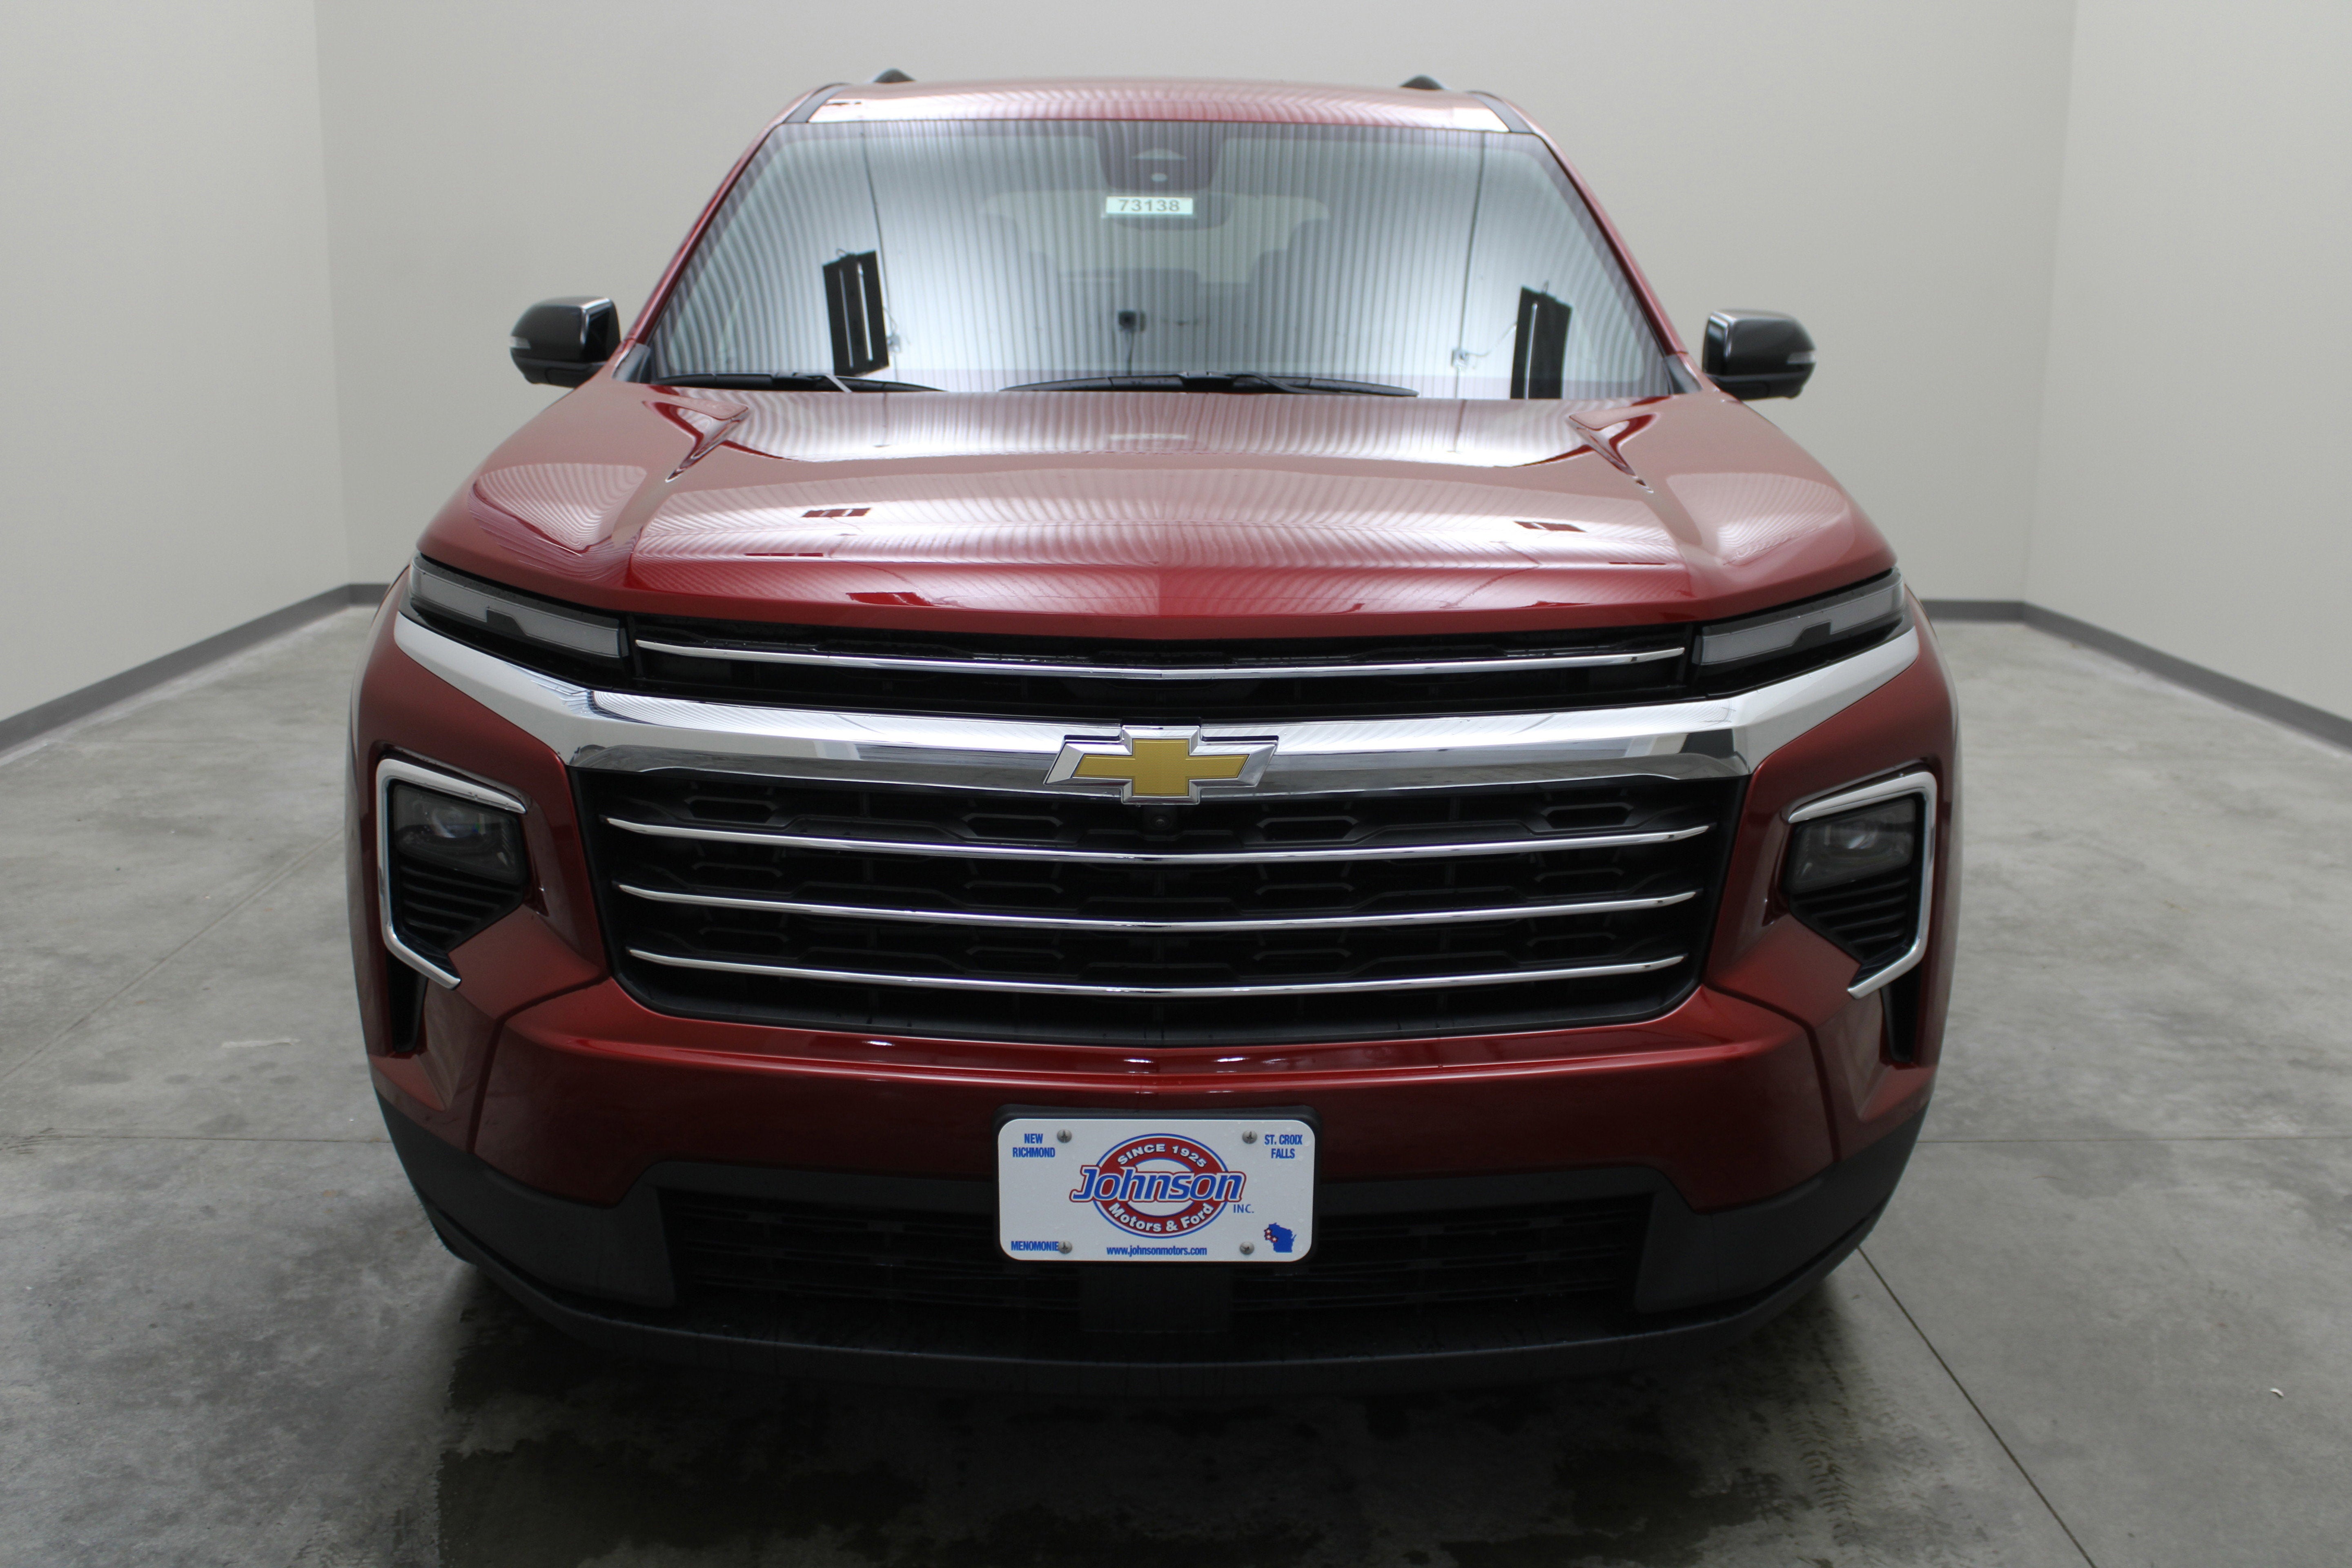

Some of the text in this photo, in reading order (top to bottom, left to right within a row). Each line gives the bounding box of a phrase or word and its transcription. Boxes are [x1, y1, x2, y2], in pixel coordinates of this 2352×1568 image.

[1119, 199, 1180, 212] 73138
[1024, 1133, 1043, 1144] NEW
[1264, 1134, 1303, 1145] ST. CROIX
[1012, 1147, 1056, 1158] RICHMOND
[1117, 1143, 1207, 1168] SINCE 1925
[1271, 1148, 1295, 1159] FALLS
[1071, 1167, 1243, 1200] Johnson
[1233, 1203, 1254, 1214] INC.
[1107, 1202, 1215, 1233] Motors & Ford
[1011, 1241, 1060, 1251] MENOMONIE
[1106, 1245, 1207, 1257] www.johnsonmotors.com
